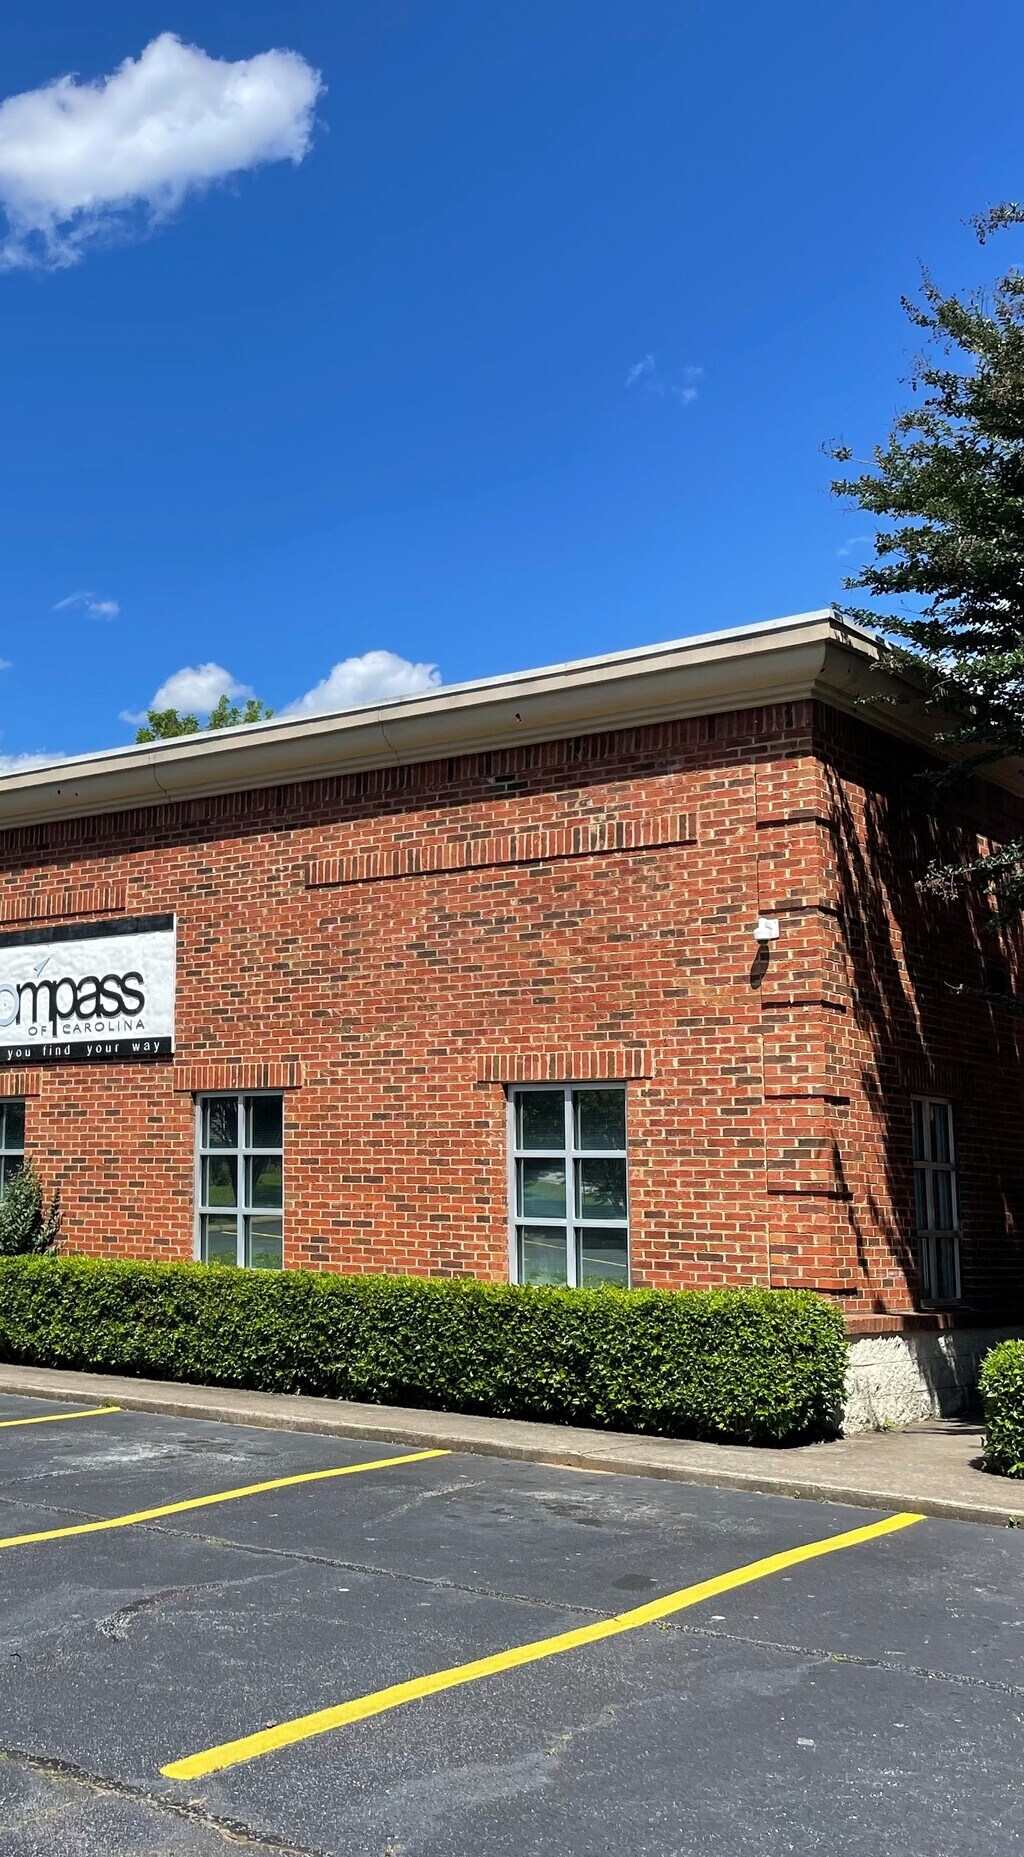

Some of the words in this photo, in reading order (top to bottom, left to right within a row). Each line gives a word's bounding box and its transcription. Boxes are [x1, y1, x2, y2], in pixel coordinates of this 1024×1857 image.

[28, 1025, 47, 1036] OF
[62, 1019, 145, 1035] CAROLINA
[7, 1048, 31, 1060] you
[43, 1044, 71, 1057] find
[87, 1043, 120, 1055] your
[132, 1041, 160, 1053] way
